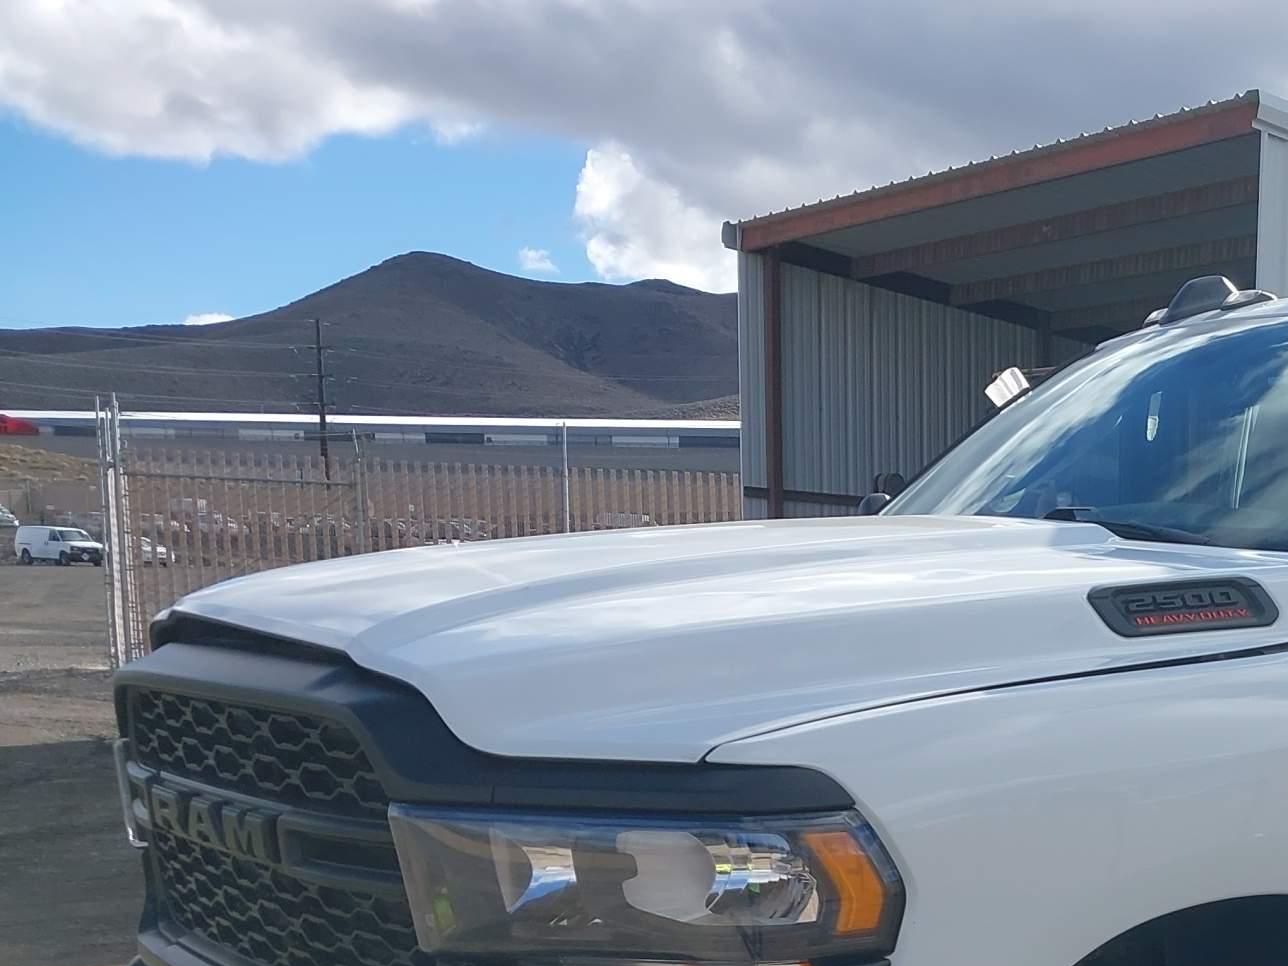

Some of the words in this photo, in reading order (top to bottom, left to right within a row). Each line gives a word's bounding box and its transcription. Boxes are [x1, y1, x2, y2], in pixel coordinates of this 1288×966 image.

[1128, 588, 1240, 611] 2500
[1136, 612, 1196, 626] HEAVY
[1200, 608, 1249, 621] DUTY
[151, 784, 273, 863] RAM
